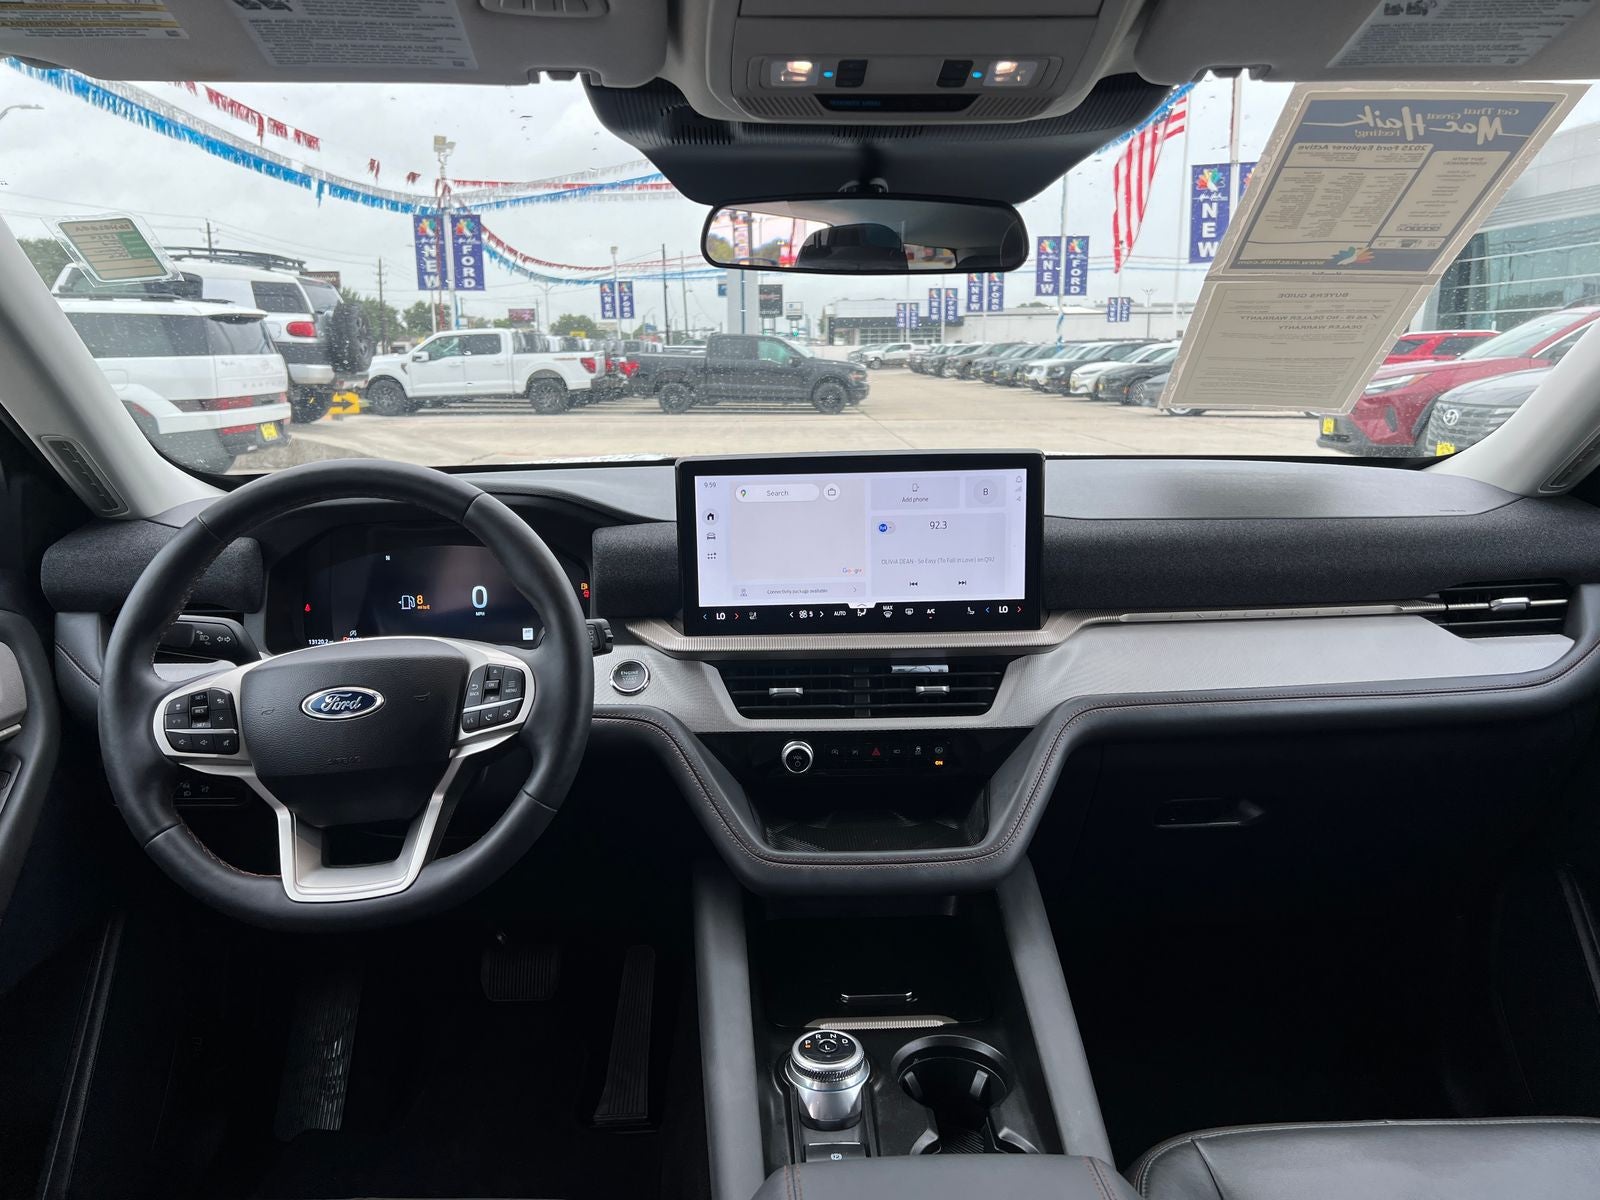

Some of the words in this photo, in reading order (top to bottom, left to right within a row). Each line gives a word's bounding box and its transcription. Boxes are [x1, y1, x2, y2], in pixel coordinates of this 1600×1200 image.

[1197, 202, 1219, 258] NEW
[423, 244, 441, 289] NEW
[461, 244, 476, 288] FORD
[1041, 260, 1054, 294] NEW
[1070, 260, 1081, 294] FORD
[969, 286, 981, 311] NEW
[990, 286, 1000, 311] FORD
[766, 489, 789, 497] Search
[912, 496, 929, 504] phone
[929, 520, 948, 530] 92.3
[416, 594, 424, 605] 8
[472, 585, 488, 609] 0
[716, 612, 726, 620] LO
[320, 693, 362, 712] Ford
